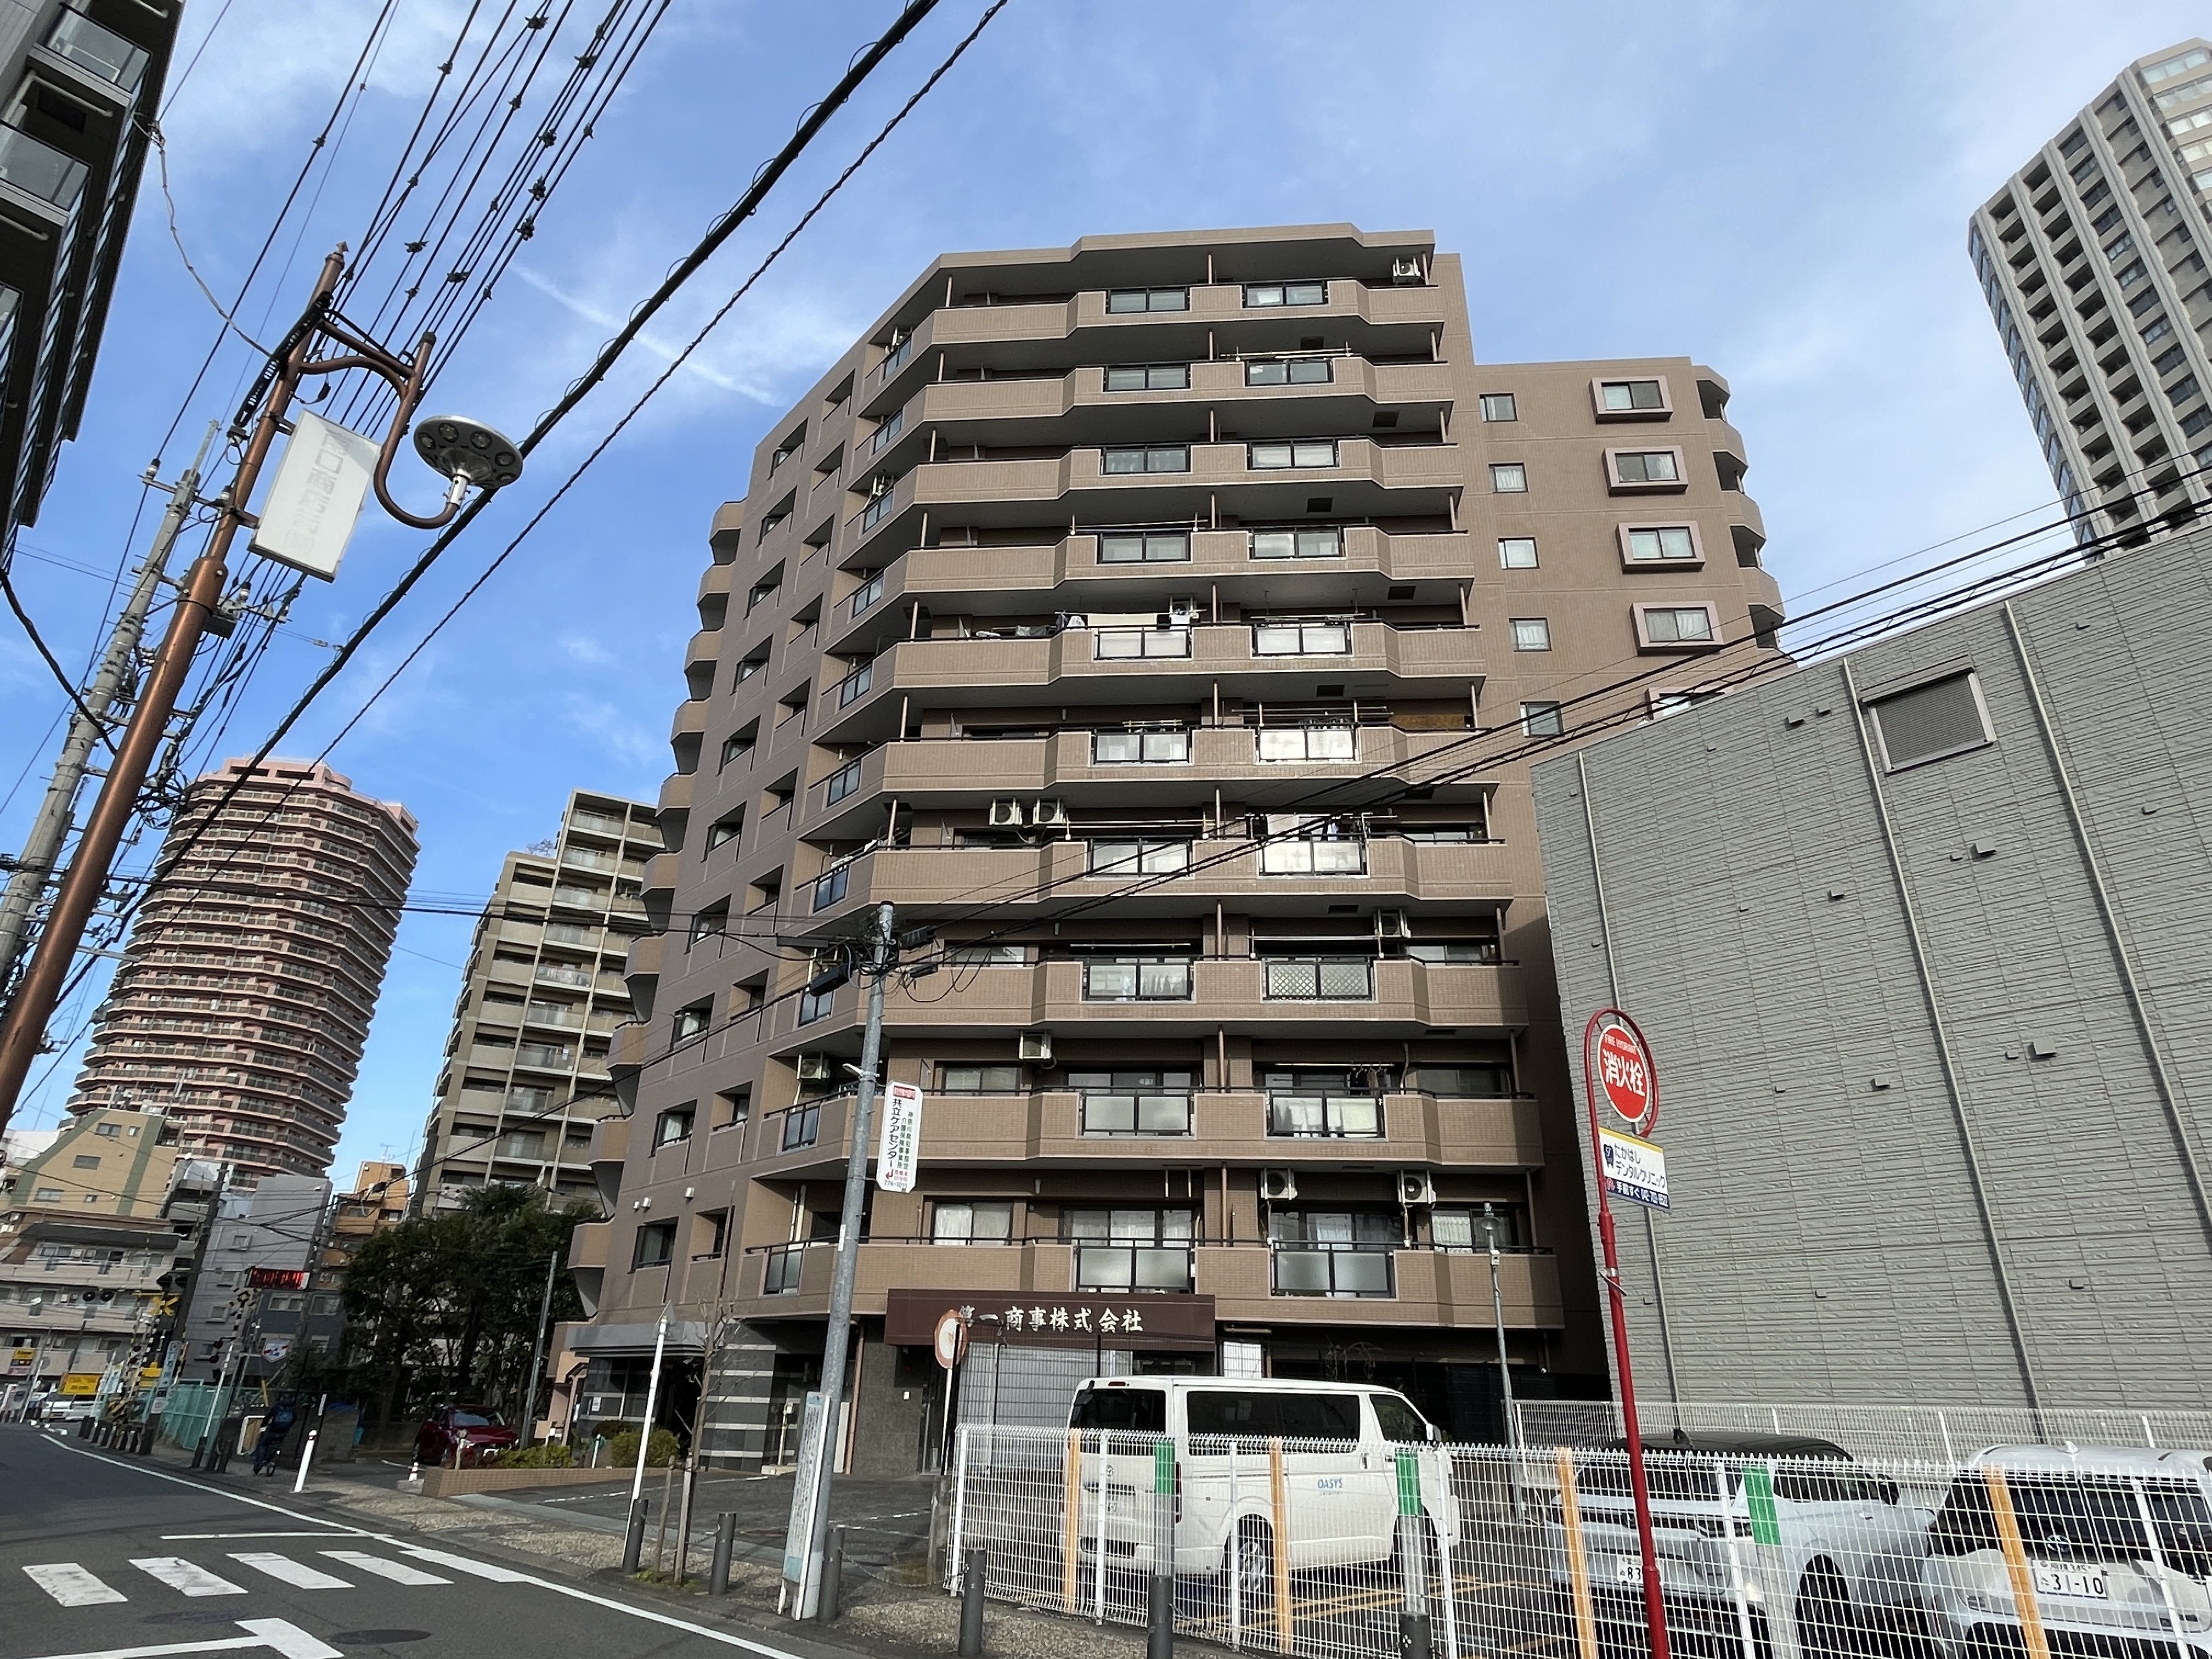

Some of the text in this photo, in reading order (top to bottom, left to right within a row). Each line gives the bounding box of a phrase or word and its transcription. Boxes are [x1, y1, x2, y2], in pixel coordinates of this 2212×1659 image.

[1602, 1048, 1646, 1097] 消火栓
[887, 1098, 902, 1167] 共立ケアセンター
[1614, 1143, 1641, 1164] たかはし
[1615, 1160, 1666, 1188] デンタルクリニック
[960, 1305, 1144, 1333] 第一商事株式会社
[1317, 1477, 1343, 1489] OASYS
[2051, 1573, 2104, 1594] 31-10
